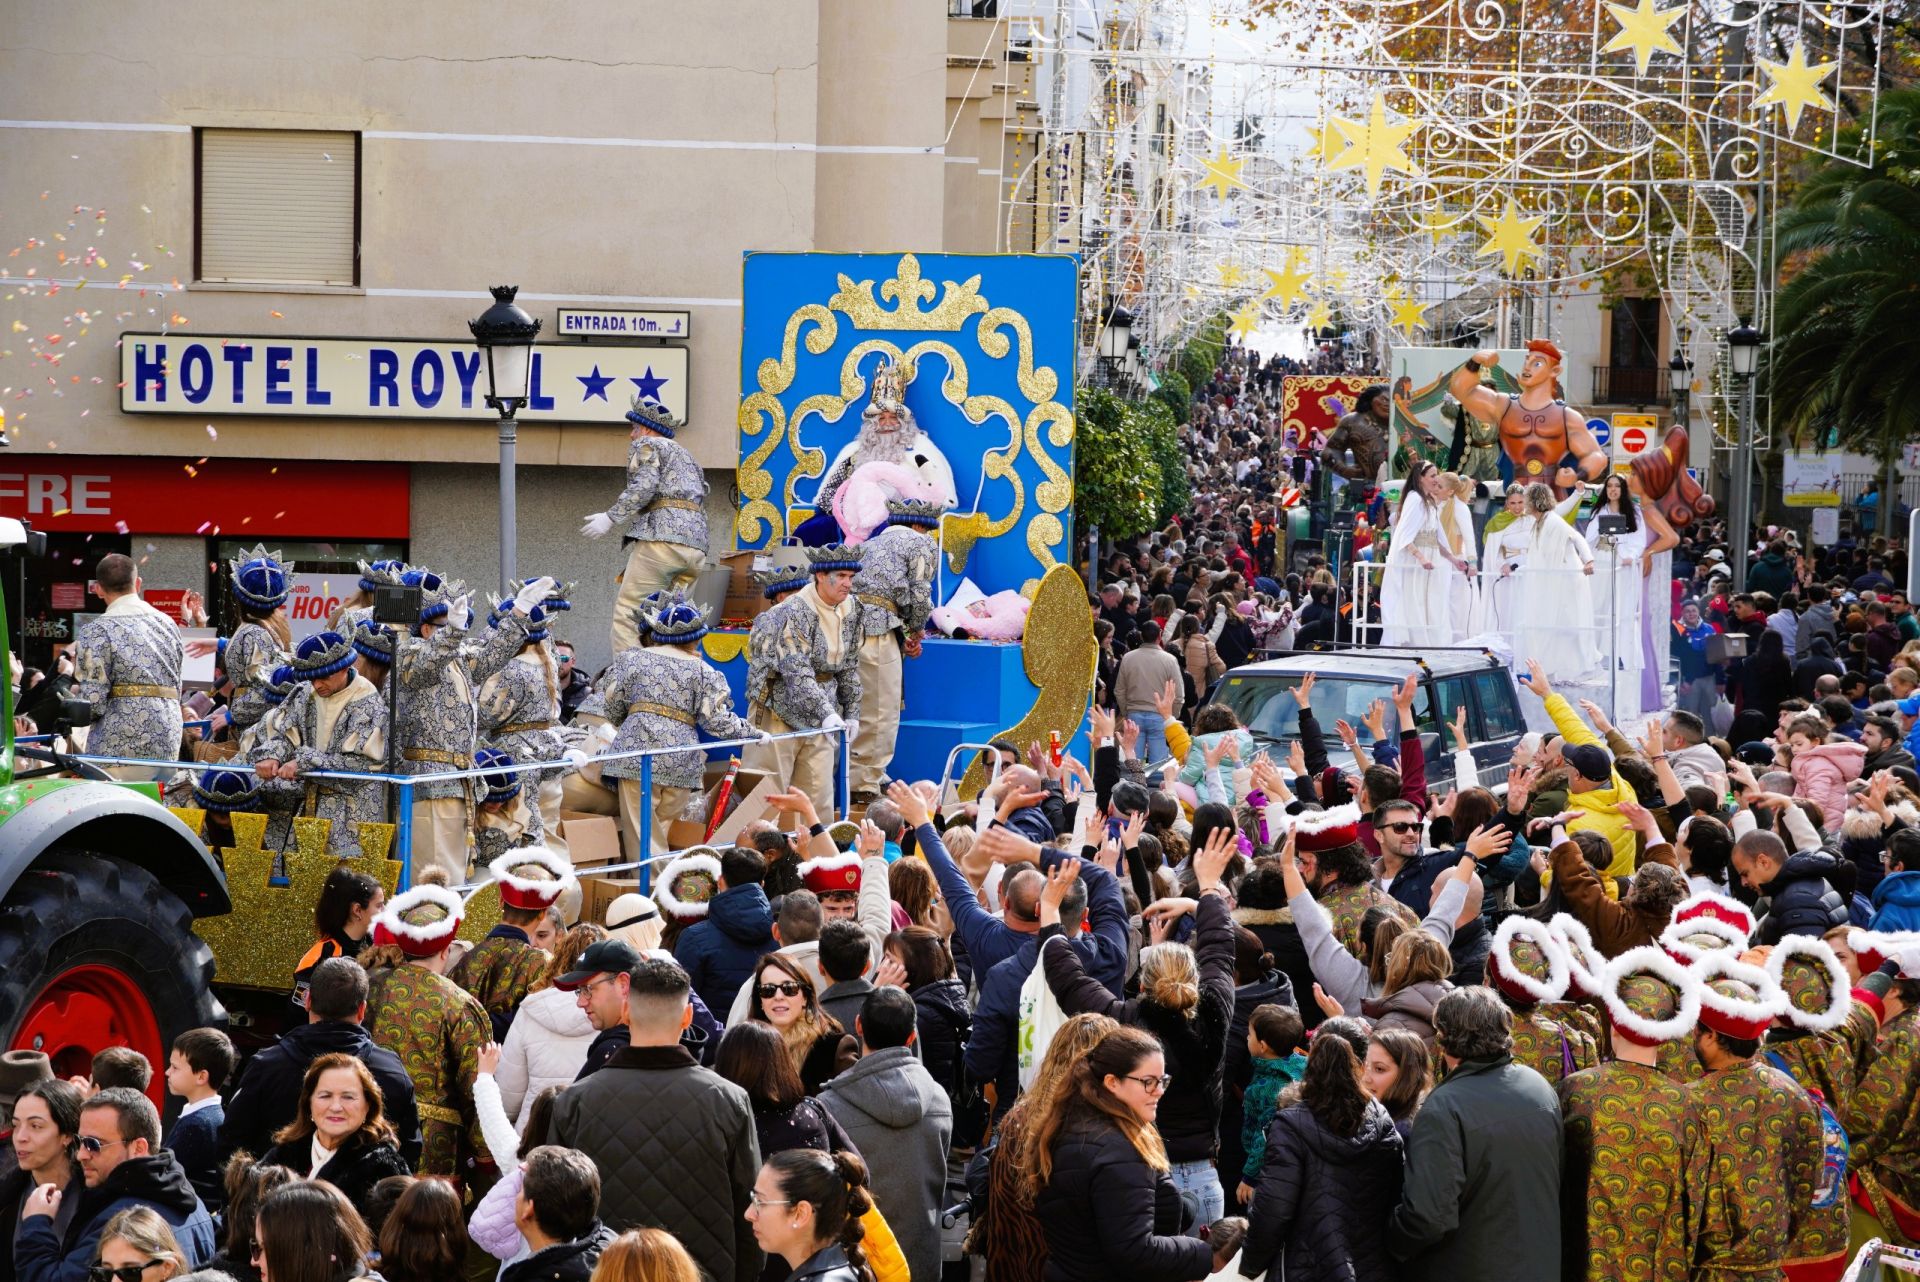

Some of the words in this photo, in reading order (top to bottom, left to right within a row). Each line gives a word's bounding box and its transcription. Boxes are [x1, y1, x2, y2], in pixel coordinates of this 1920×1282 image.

[566, 315, 626, 331] ENTRADA
[632, 317, 661, 331] 10m.
[135, 344, 331, 405] HOTEL
[369, 349, 554, 410] ROYL
[291, 596, 350, 619] HOG
